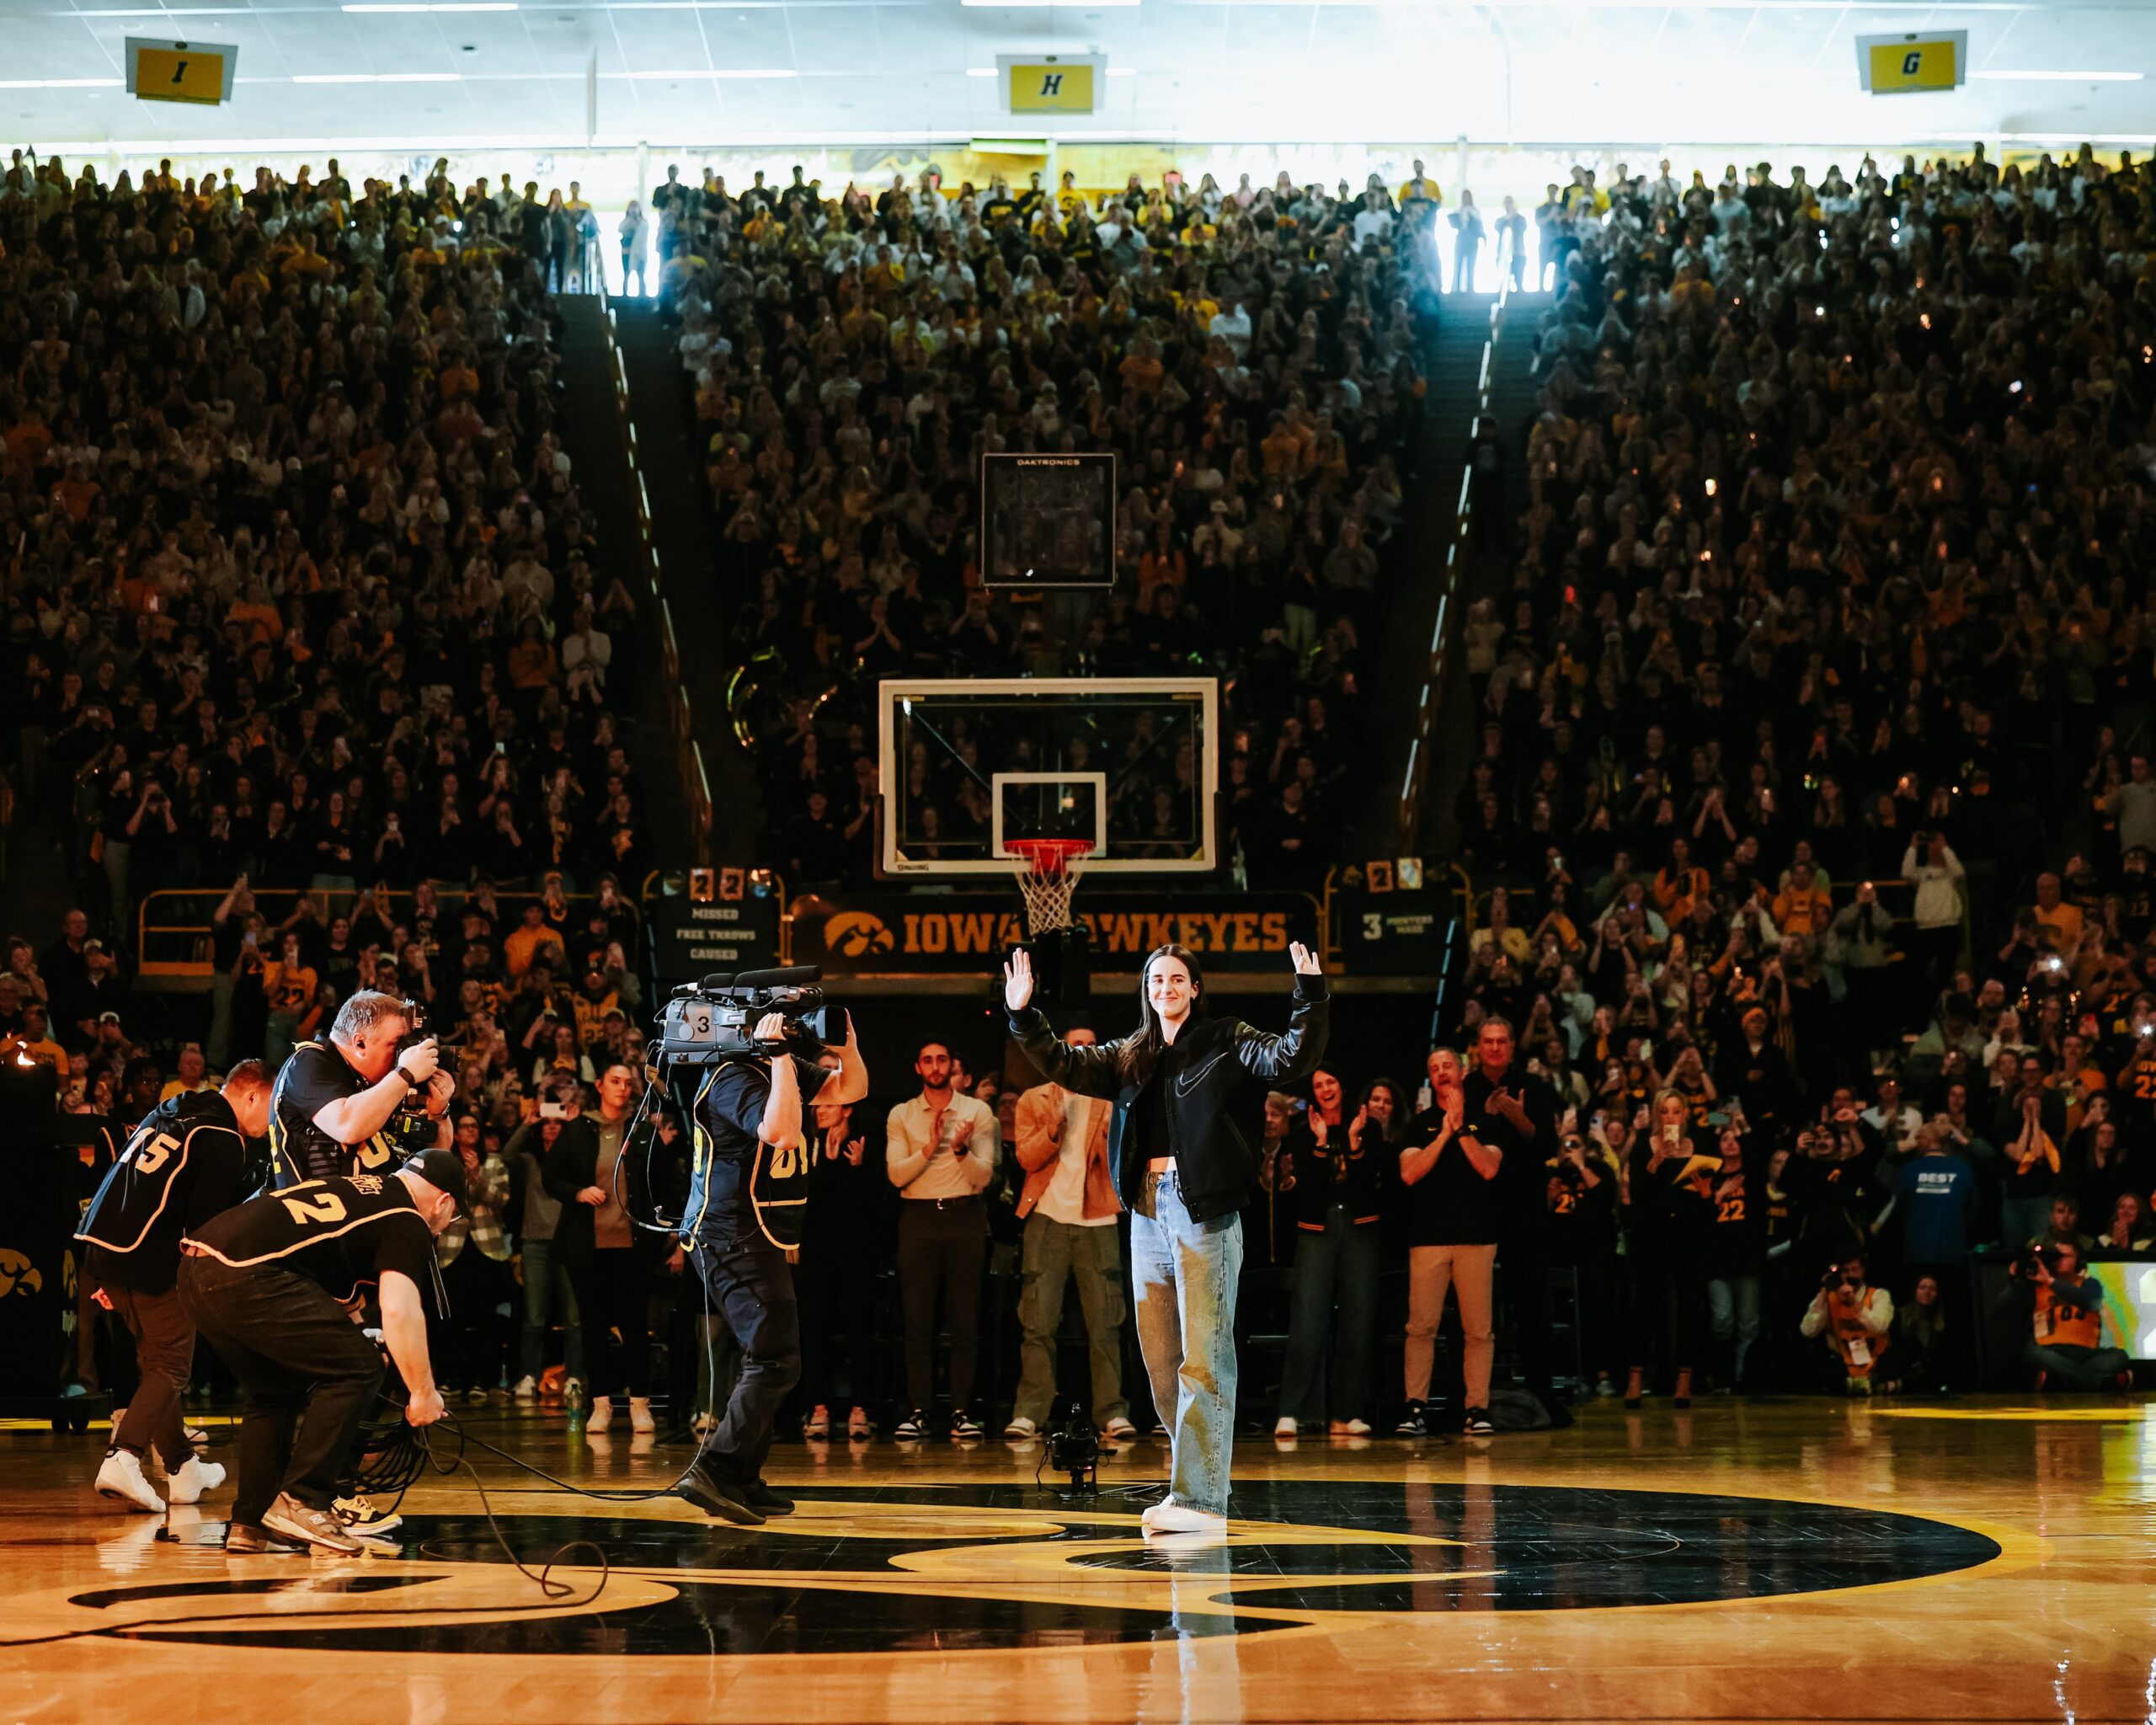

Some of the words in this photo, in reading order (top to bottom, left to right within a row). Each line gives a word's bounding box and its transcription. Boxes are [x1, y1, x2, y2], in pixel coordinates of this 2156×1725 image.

[172, 61, 188, 83] I
[1903, 51, 1922, 75] G
[1041, 75, 1063, 95] H
[695, 875, 708, 895] 2
[726, 875, 739, 895] 2
[1374, 868, 1389, 889] 2
[691, 908, 739, 921] MISSED
[676, 929, 706, 940] FREE
[708, 929, 756, 941] THROWS
[903, 913, 1022, 953] IOWA
[1081, 913, 1288, 953] WKEYES
[1363, 913, 1382, 940] 3
[690, 948, 739, 961] CAUSED
[697, 1016, 710, 1033] 3
[119, 1127, 182, 1174] 15
[1919, 1172, 1957, 1183] BEST
[269, 1180, 348, 1225] 12
[1716, 1199, 1746, 1224] 22
